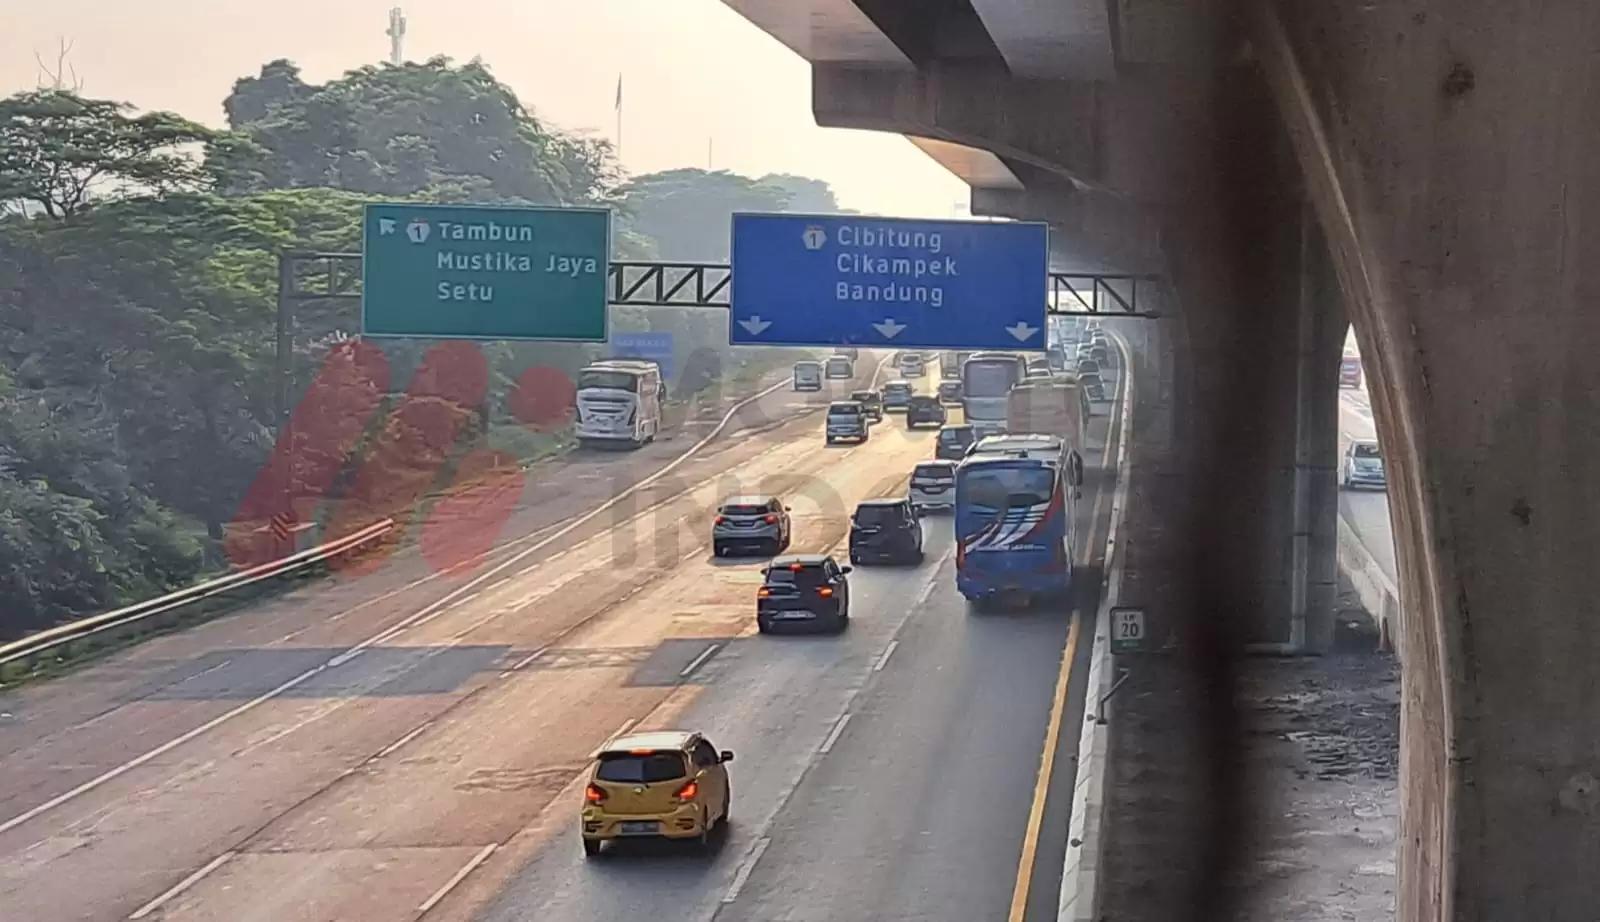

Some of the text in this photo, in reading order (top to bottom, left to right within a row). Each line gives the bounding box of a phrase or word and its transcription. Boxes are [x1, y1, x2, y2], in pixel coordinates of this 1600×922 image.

[413, 221, 532, 241] 1 Tambun
[809, 226, 941, 252] 1 Cibitung
[437, 252, 597, 277] Mustika Jaya
[836, 253, 958, 277] Cikampek
[437, 281, 493, 300] Setu
[836, 281, 944, 307] Bandung
[1121, 623, 1138, 638] 20
